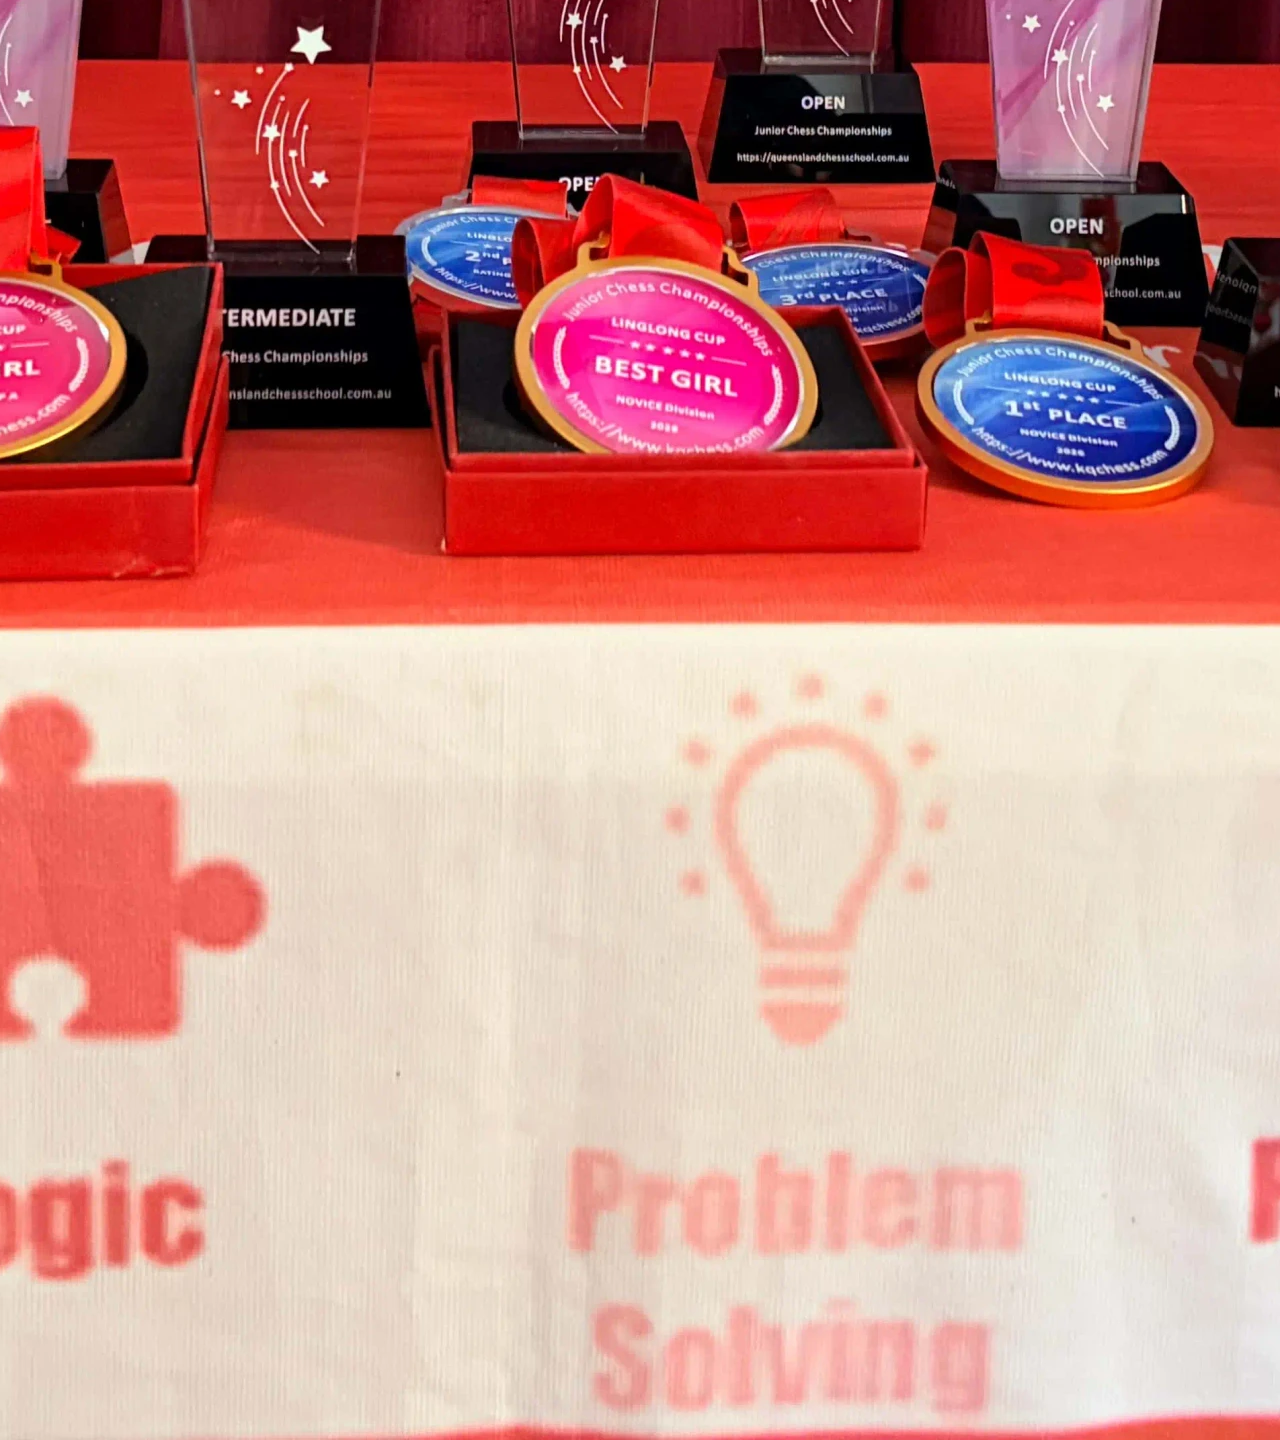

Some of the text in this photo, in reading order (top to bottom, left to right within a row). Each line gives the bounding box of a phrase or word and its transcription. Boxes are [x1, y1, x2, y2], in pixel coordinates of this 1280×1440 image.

[801, 96, 845, 109] OPEN
[755, 126, 892, 136] Junior Chess Championships
[737, 152, 909, 162] https://queenslandchessschool.com.au
[1050, 218, 1103, 234] OPEN
[772, 268, 868, 282] LINGLONG CUP
[780, 288, 888, 306] 3rd PLACE
[564, 282, 772, 357] Junior Chess Championships
[611, 317, 725, 346] LINGLONG CUP
[264, 350, 368, 365] Championships
[595, 355, 738, 397] BEST GIRL
[957, 347, 1162, 400] Junior Chess Championships
[1004, 372, 1116, 393] LINGLONG CUP
[1006, 399, 1127, 429] 1st PLACE
[567, 1146, 1023, 1257] Problem
[590, 1298, 989, 1414] Solving
